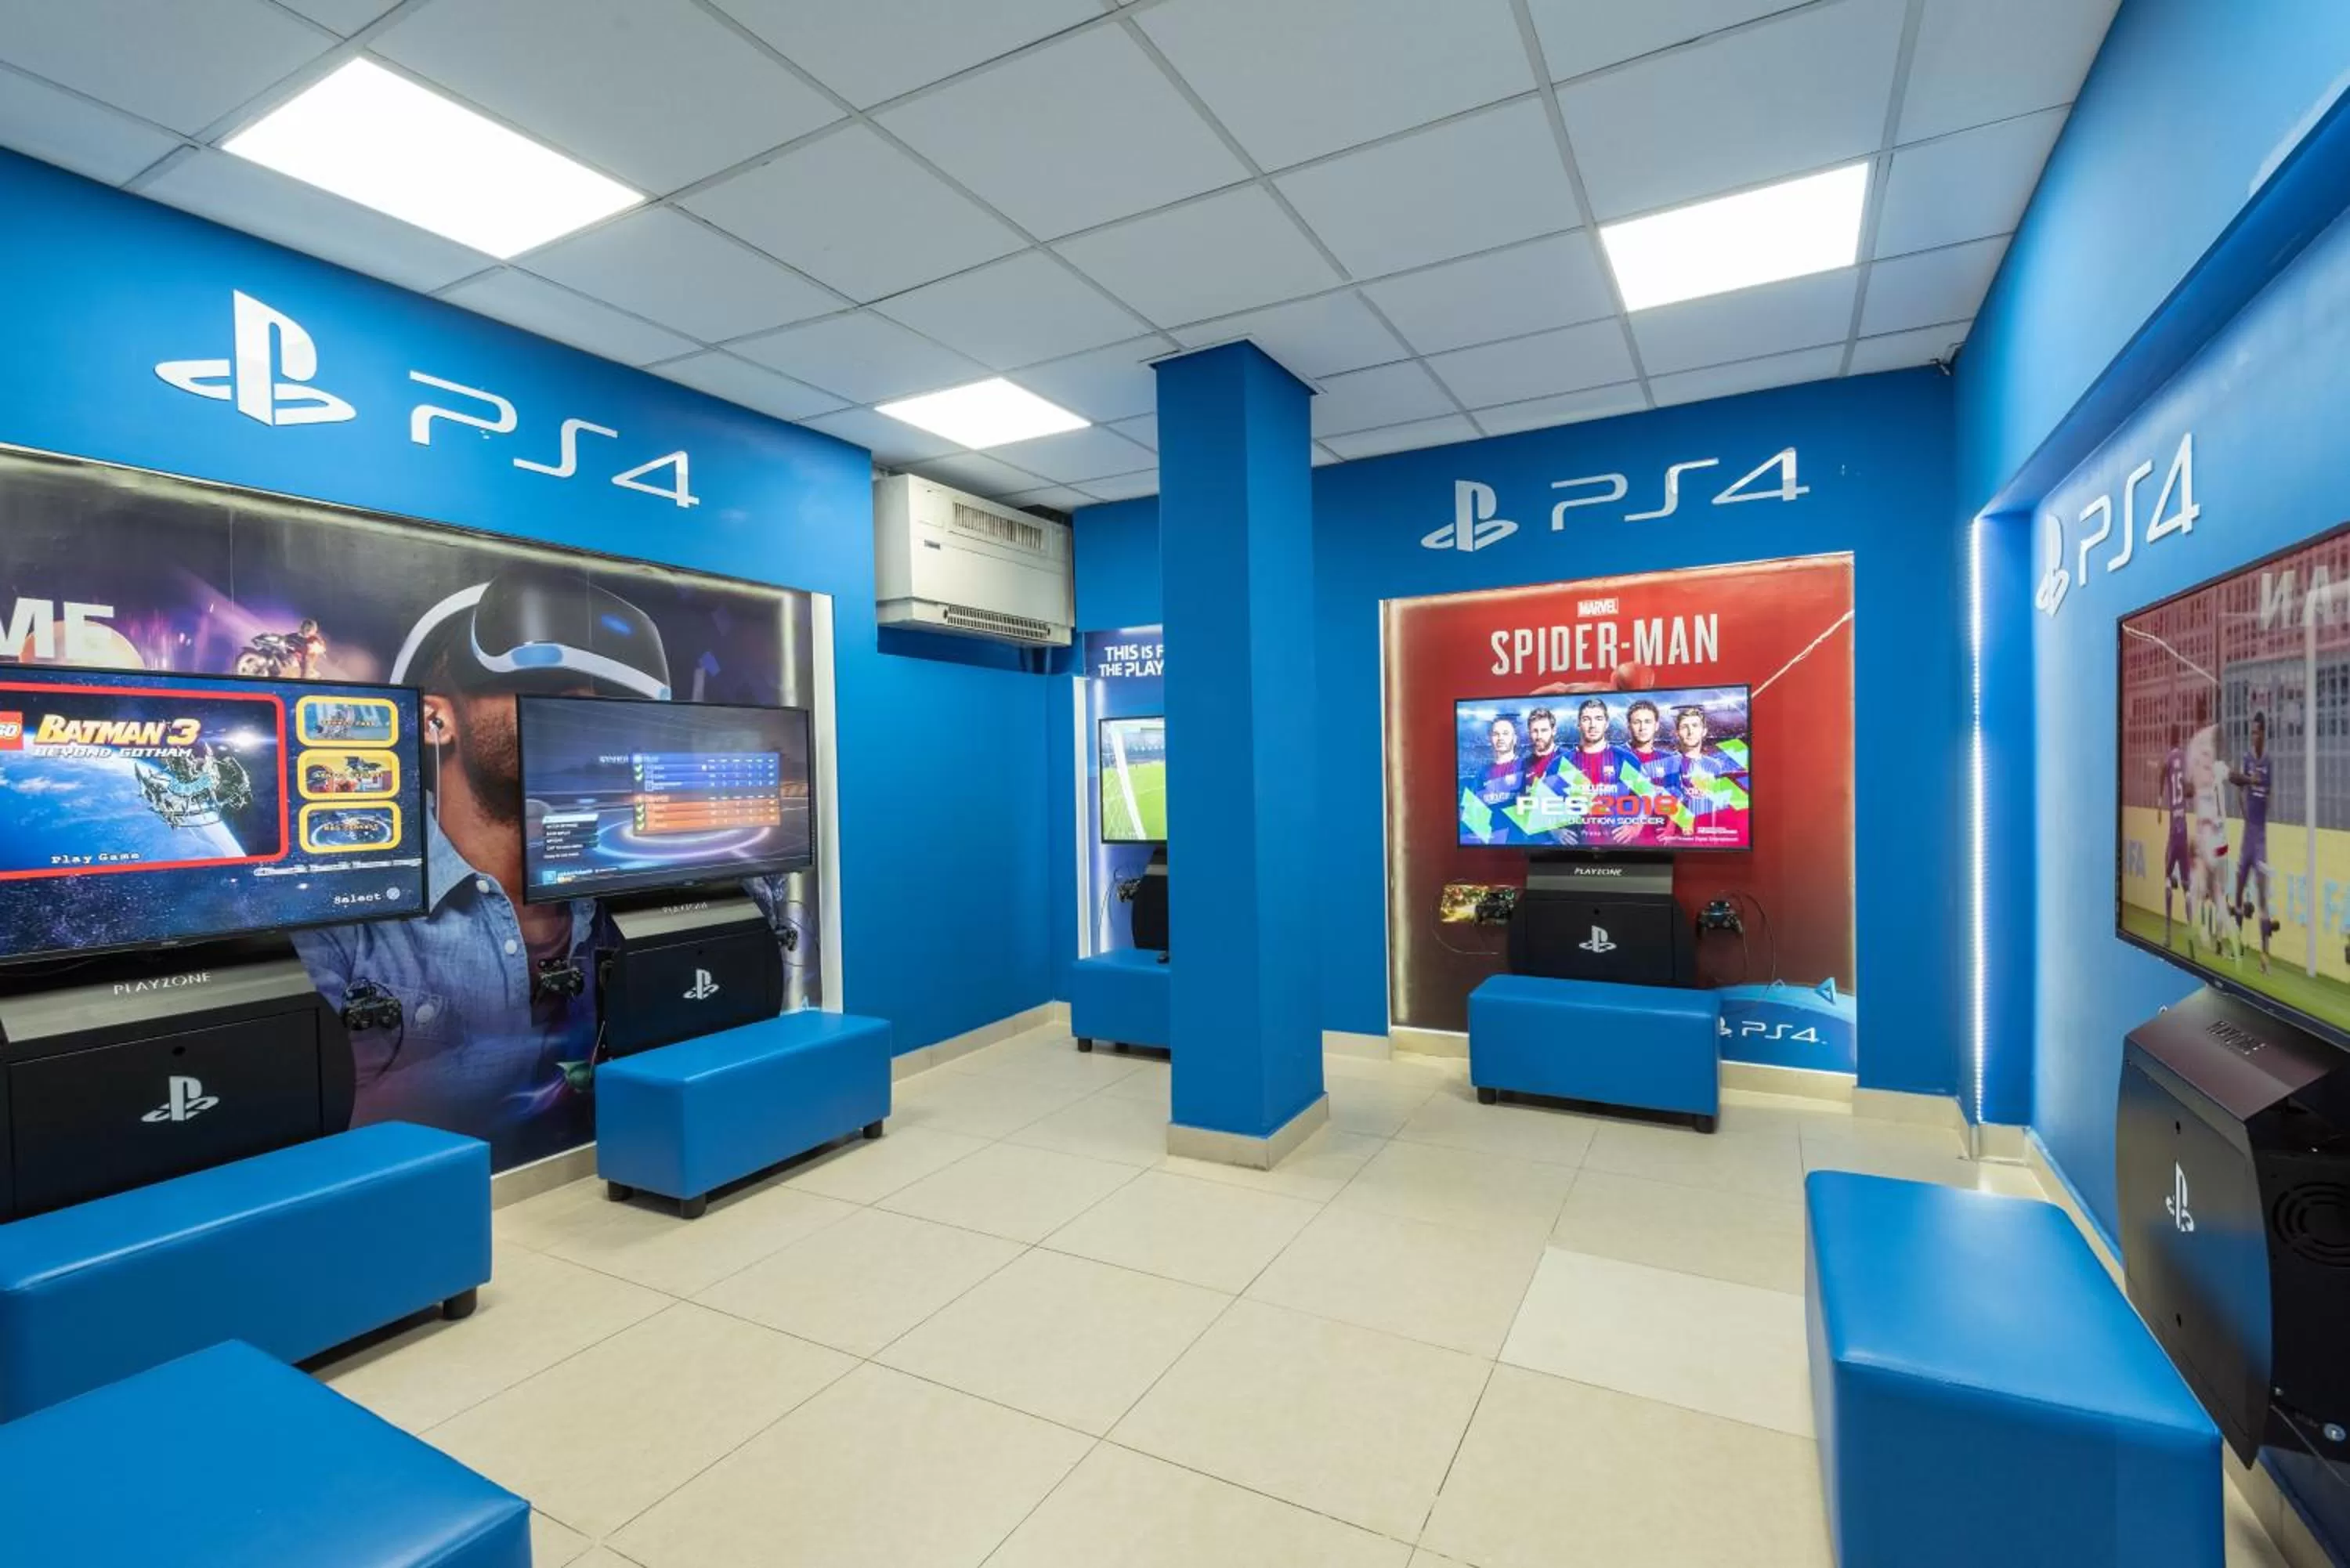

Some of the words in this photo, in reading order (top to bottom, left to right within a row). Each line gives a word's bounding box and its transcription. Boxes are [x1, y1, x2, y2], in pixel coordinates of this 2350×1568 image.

[410, 370, 700, 508] PS4
[1552, 447, 1810, 531] PS4
[2078, 432, 2201, 587] PS4
[1104, 644, 1138, 662] THIS
[1141, 645, 1153, 659] IS
[1491, 613, 1719, 677] SPIDER-MAN
[1098, 663, 1123, 677] THE
[34, 714, 166, 746] BATMAN
[167, 718, 201, 746] 3
[119, 747, 193, 758] GOTHAM
[1618, 816, 1665, 825] SOCCER
[50, 854, 92, 865] Play
[99, 852, 140, 861] Game
[334, 892, 381, 906] Select
[114, 971, 212, 995] PLAYZONE
[1741, 1021, 1820, 1043] PS4
